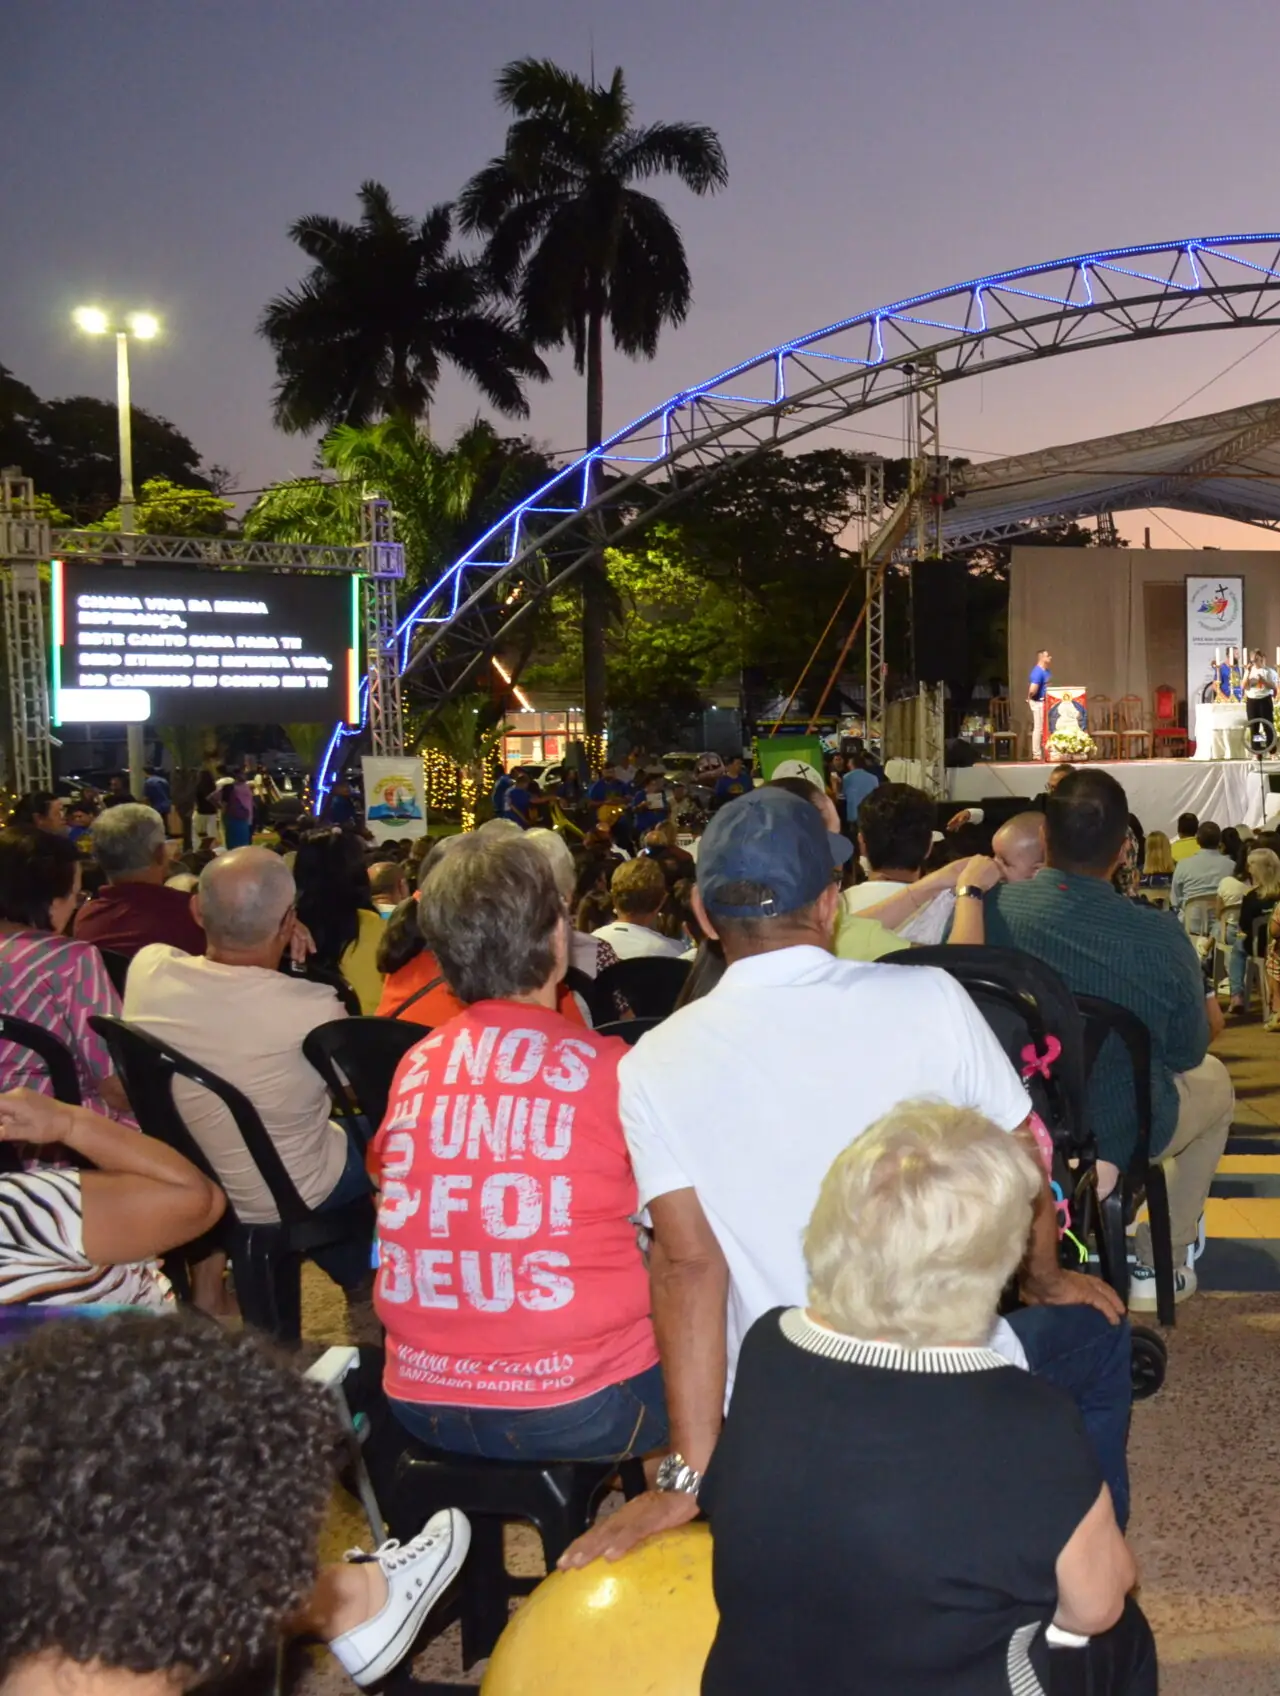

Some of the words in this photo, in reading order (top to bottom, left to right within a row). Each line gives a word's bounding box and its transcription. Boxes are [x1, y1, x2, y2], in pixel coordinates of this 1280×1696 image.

[443, 1027, 596, 1092] NOS
[430, 1094, 576, 1163] UNIU
[430, 1173, 573, 1240] FOI
[379, 1240, 575, 1312] DEUS
[476, 1379, 536, 1391] PADRE
[541, 1374, 575, 1391] PIO
